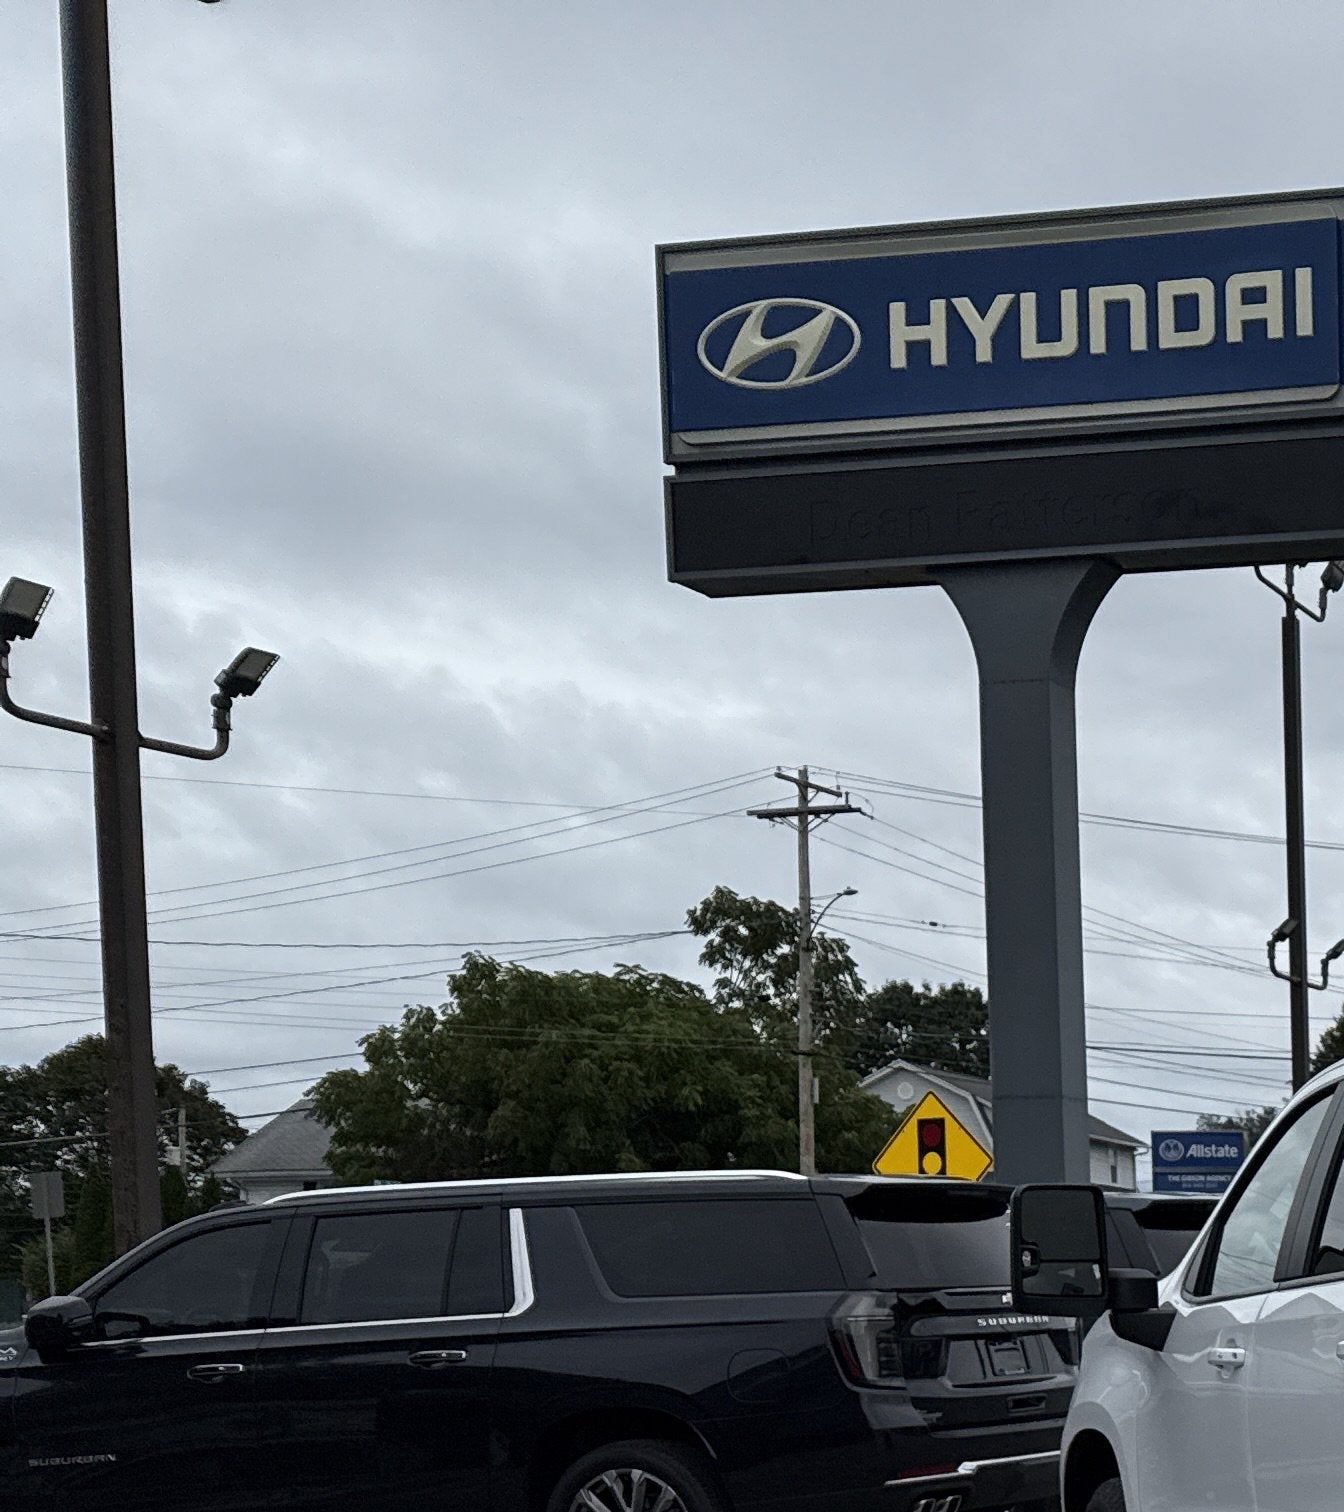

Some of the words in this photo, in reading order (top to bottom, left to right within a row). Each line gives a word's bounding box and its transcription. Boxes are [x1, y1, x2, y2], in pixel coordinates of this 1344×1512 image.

[889, 267, 1314, 369] HYUNDAI
[1186, 1143, 1239, 1158] Allstate
[977, 1316, 1049, 1327] SUBURBAN
[28, 1454, 116, 1467] SUBURBAN
